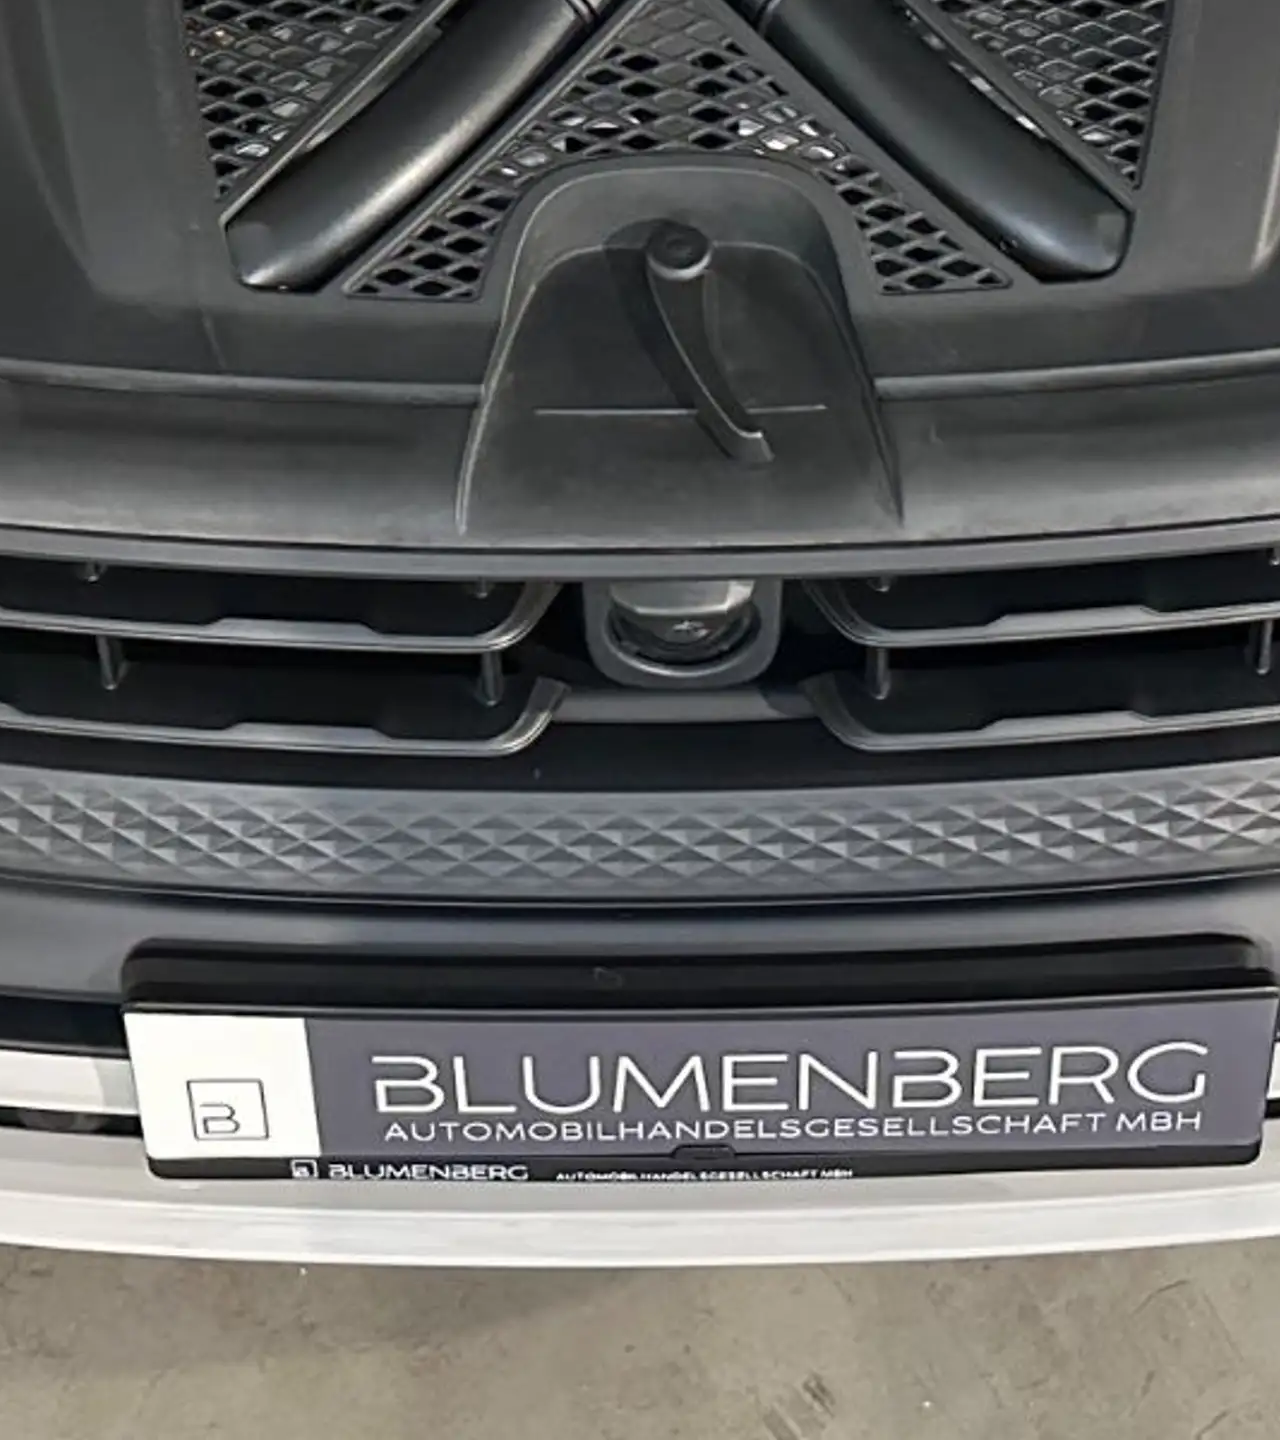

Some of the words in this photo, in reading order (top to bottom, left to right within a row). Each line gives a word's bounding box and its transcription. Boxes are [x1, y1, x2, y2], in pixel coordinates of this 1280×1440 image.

[371, 1041, 1209, 1115] BLUMENBERG
[384, 1113, 1107, 1143] AUTOMOBILHANDELSGESELLSCHAFT
[1115, 1111, 1202, 1133] MBH
[328, 1164, 529, 1180] BLUMENBERG
